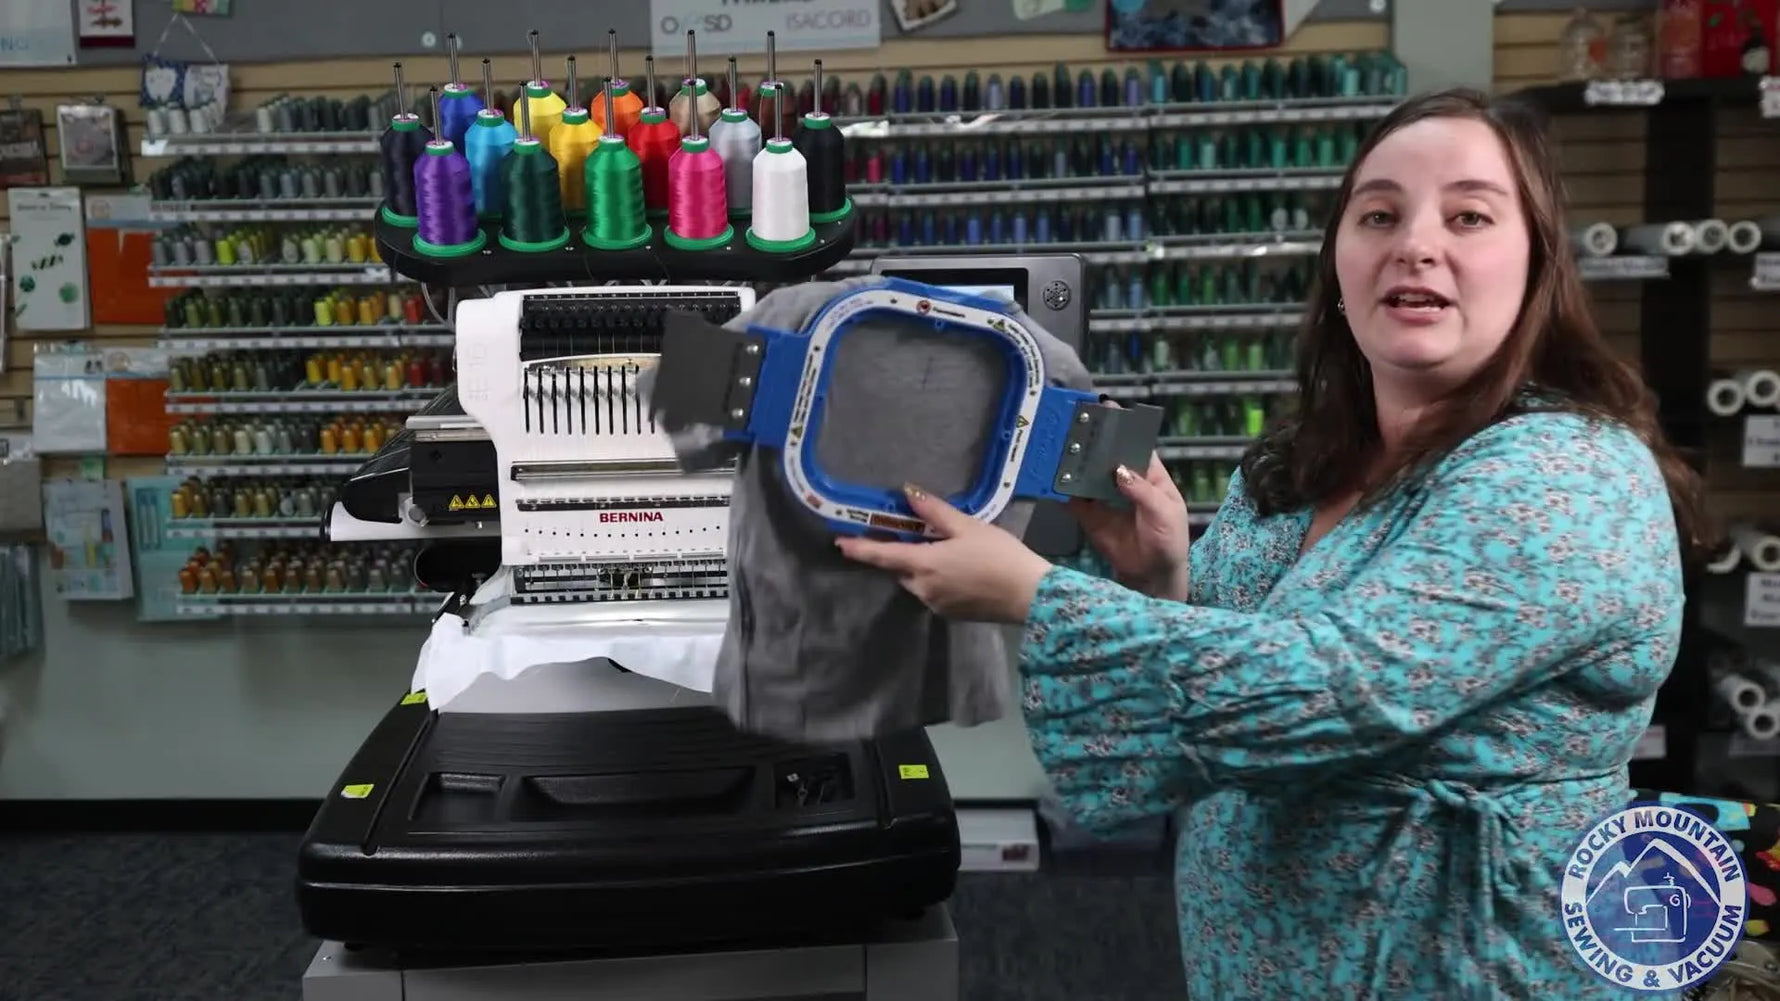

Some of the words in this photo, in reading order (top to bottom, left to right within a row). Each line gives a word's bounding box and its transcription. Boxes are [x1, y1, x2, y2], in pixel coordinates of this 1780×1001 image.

[660, 13, 733, 35] OSD
[786, 9, 872, 30] ISACORD
[599, 511, 664, 523] BERNINA
